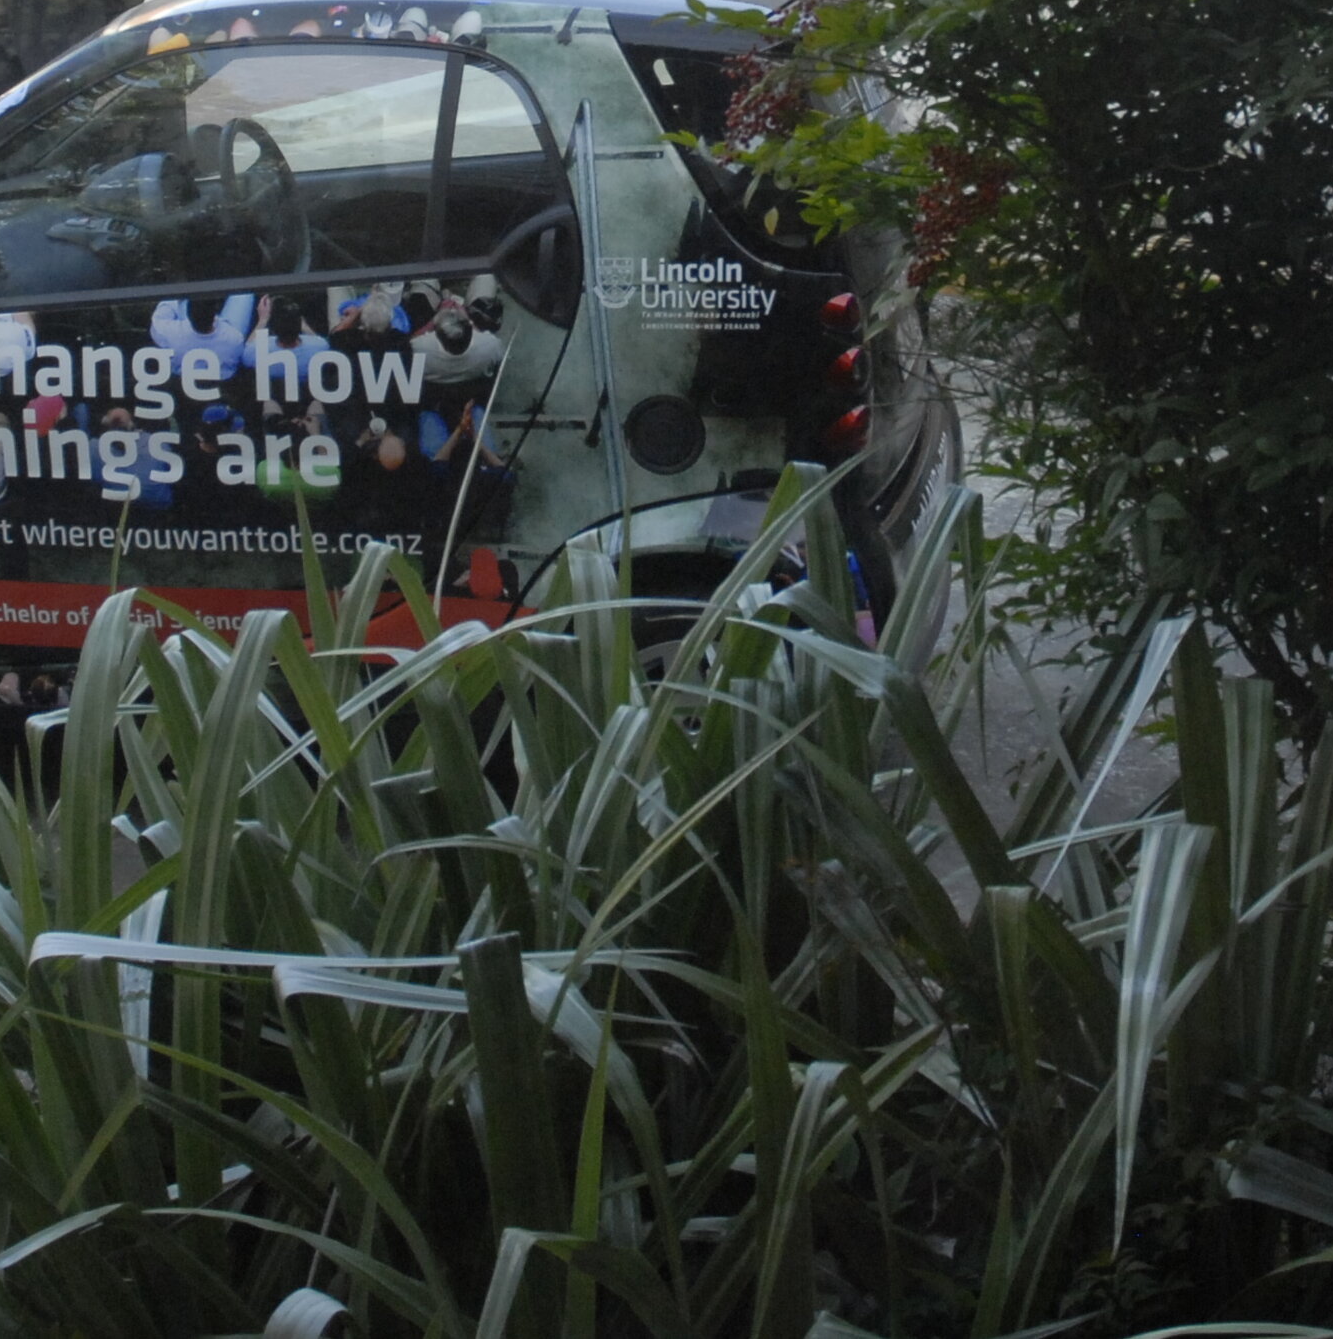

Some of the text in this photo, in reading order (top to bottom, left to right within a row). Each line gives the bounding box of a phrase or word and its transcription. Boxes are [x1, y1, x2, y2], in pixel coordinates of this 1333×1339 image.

[641, 258, 742, 283] Lincoln
[641, 284, 776, 315] University
[255, 328, 426, 404] how
[216, 432, 341, 487] are
[22, 518, 423, 556] whereyouwanttobe.conz
[66, 606, 90, 625] of
